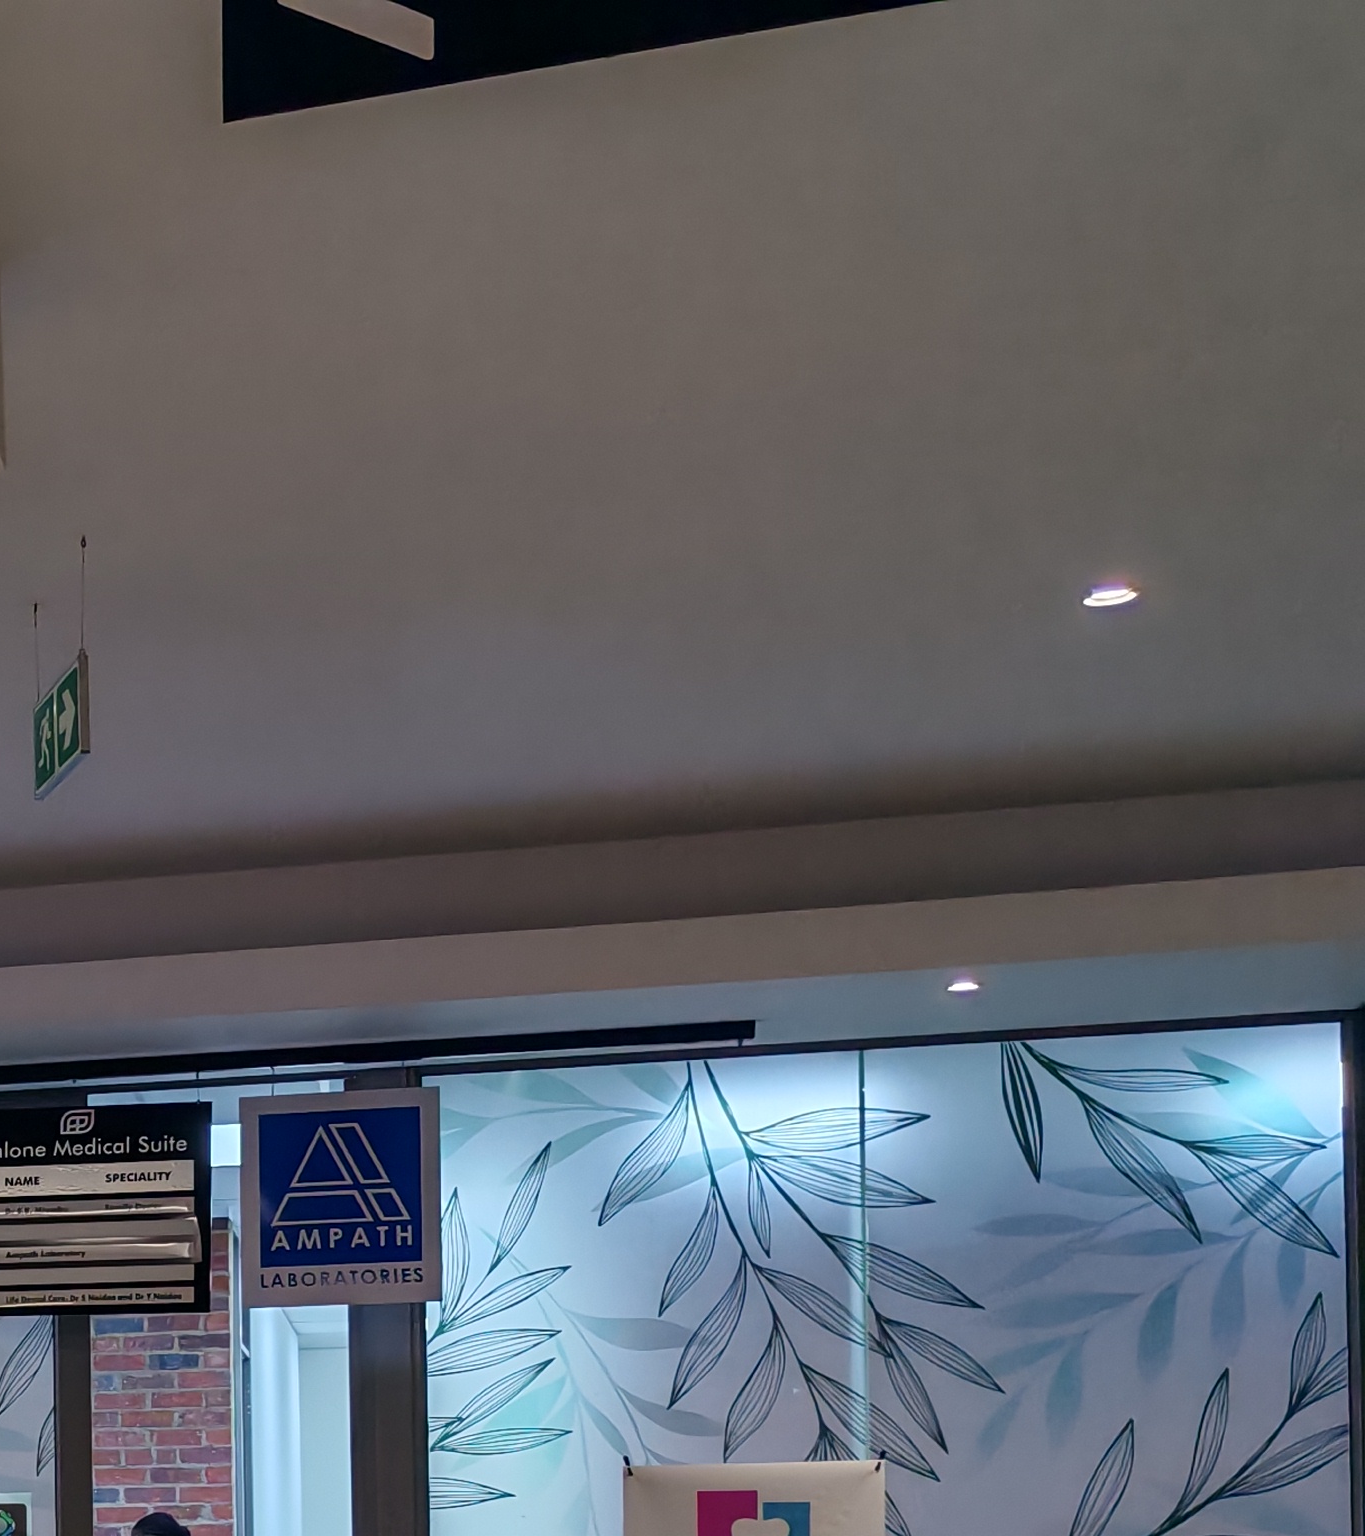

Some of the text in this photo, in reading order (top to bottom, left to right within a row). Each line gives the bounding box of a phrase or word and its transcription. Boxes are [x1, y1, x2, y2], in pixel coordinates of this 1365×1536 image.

[53, 1136, 130, 1157] Medical
[138, 1134, 188, 1153] Suite
[4, 1176, 40, 1187] NAME
[105, 1171, 172, 1183] SPECIALITY
[271, 1224, 413, 1251] AMPATH
[5, 1251, 38, 1260] Ampath
[260, 1267, 423, 1289] LABORATORIES
[5, 1296, 19, 1304] Life
